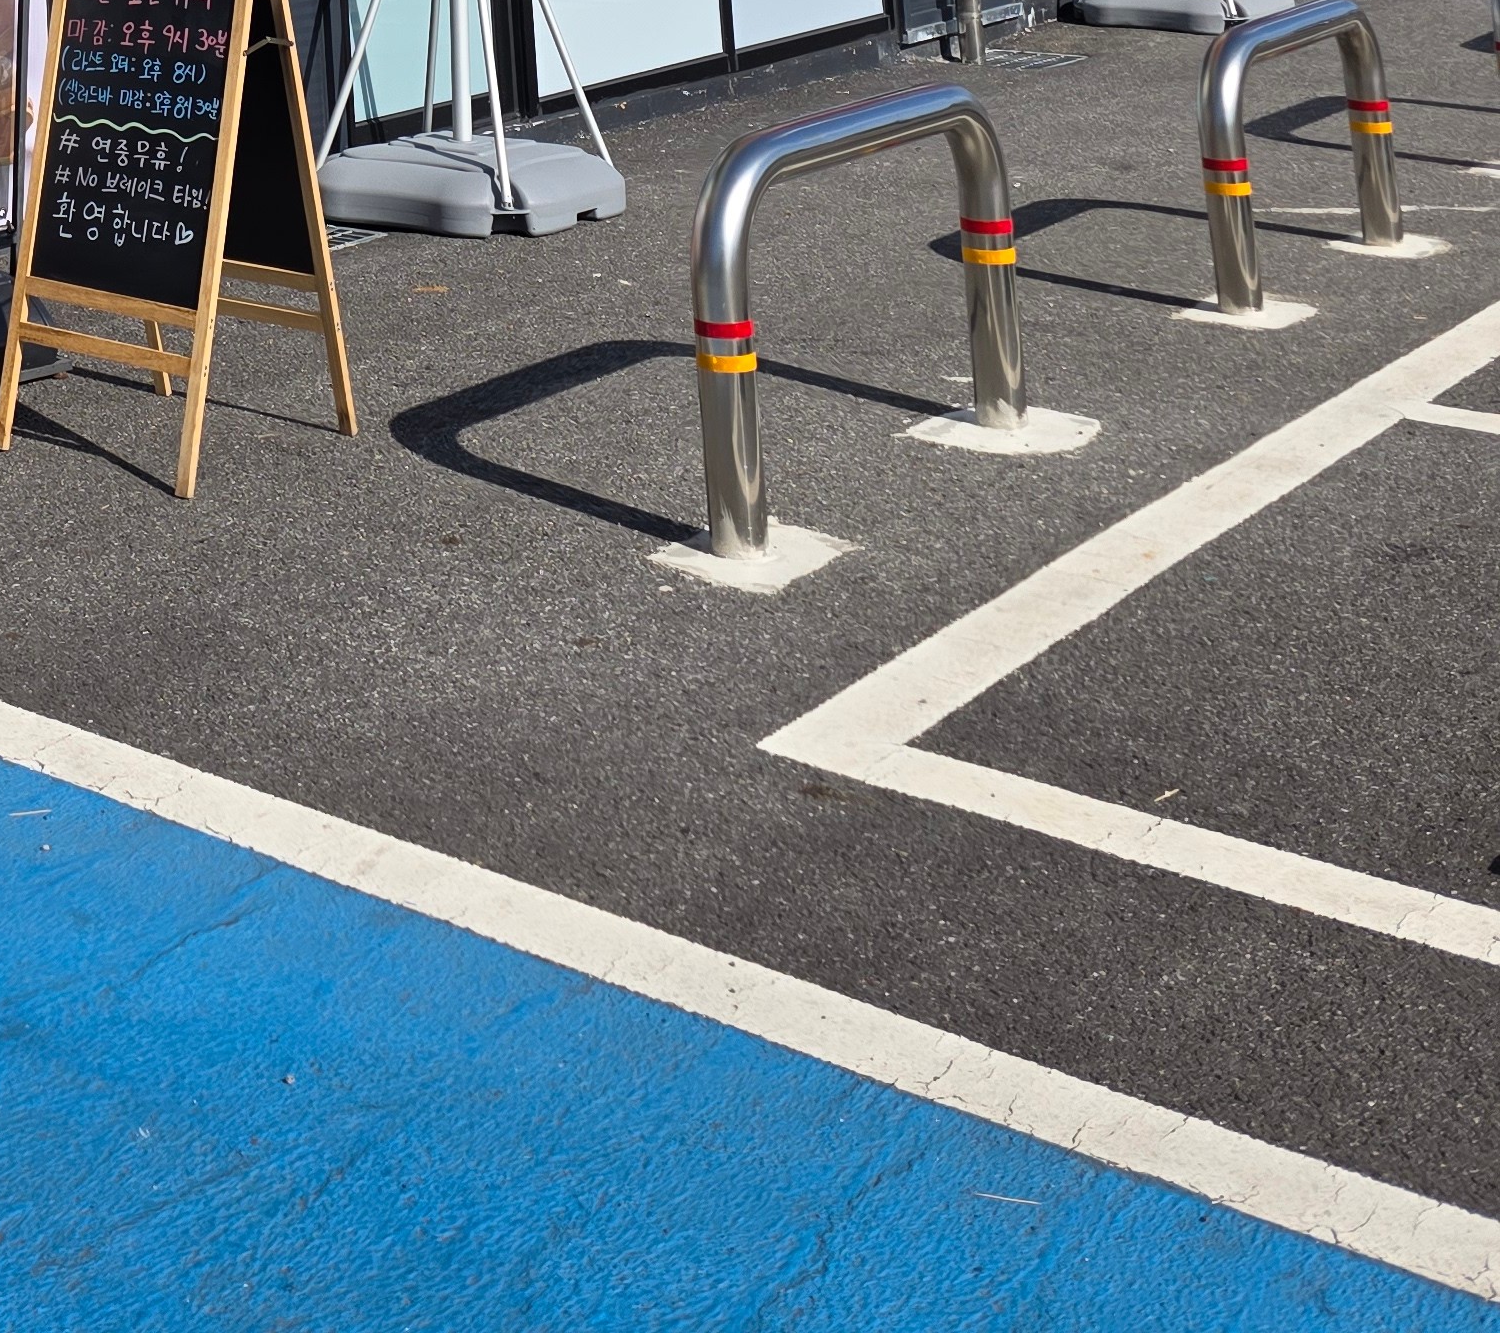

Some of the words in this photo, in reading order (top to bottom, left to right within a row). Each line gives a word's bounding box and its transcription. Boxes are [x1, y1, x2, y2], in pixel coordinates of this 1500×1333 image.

[120, 19, 155, 55] 오후
[162, 24, 189, 54] 9시
[195, 28, 228, 59] 30분
[138, 57, 163, 83] 오후
[172, 61, 206, 85] 8시)
[195, 97, 220, 120] 30분
[75, 166, 98, 187] No
[101, 171, 165, 201] 브레이크
[172, 184, 211, 210] 타임!
[52, 191, 171, 248] 환영합니다
